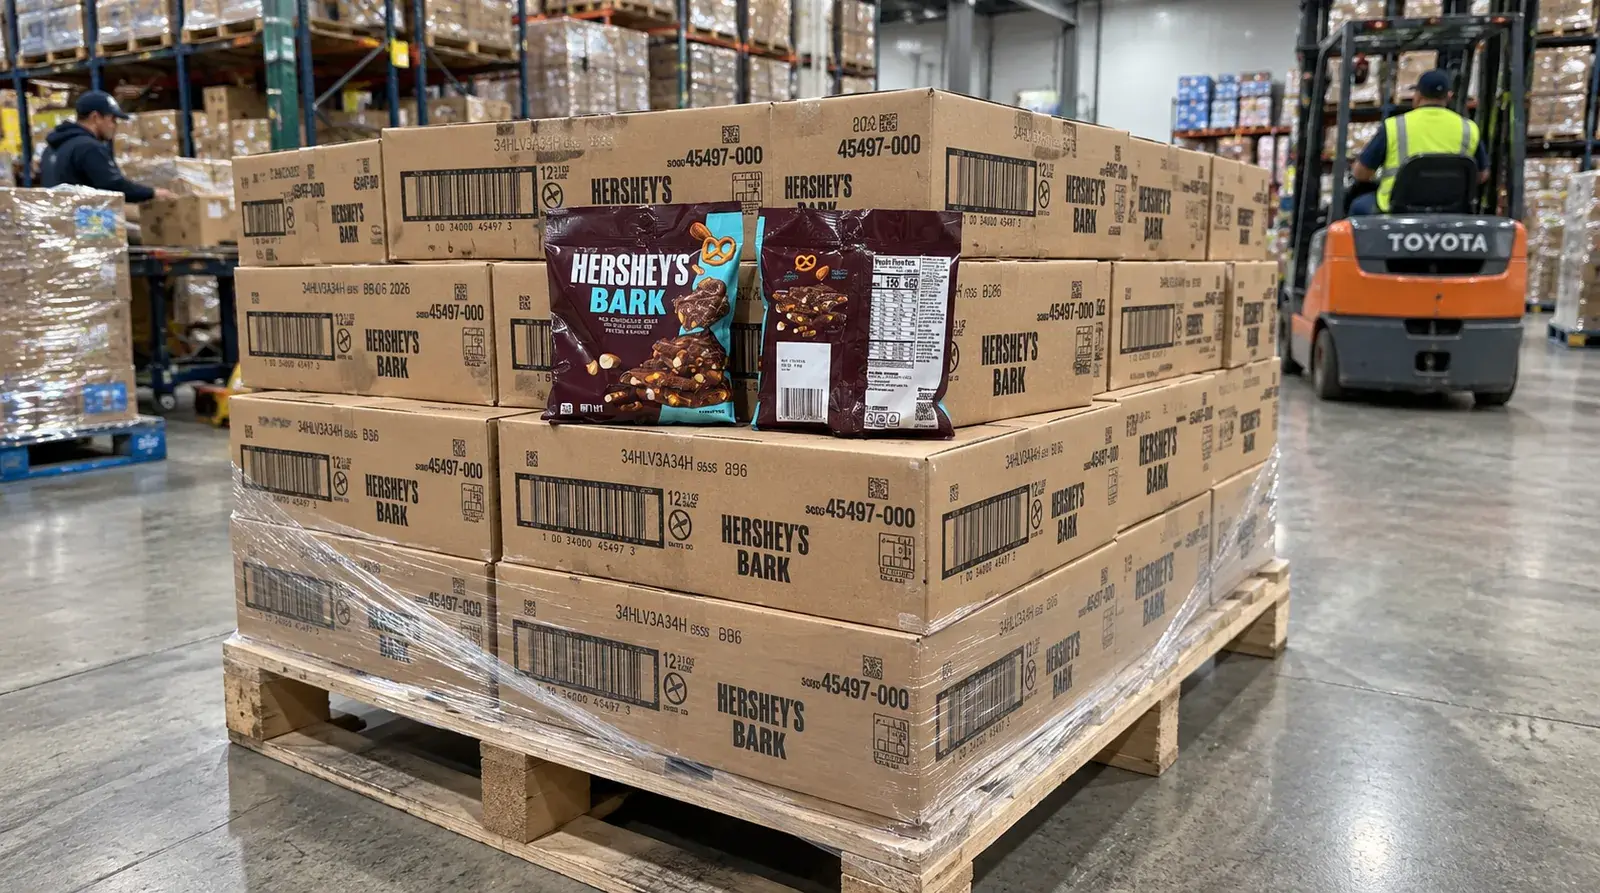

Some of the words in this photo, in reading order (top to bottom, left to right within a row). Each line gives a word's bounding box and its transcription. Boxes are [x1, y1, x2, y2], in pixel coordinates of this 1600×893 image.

[685, 145, 764, 168] 45497-000
[837, 134, 921, 159] 45497-000
[591, 175, 673, 205] HERSHEY'S
[784, 173, 852, 200] HERSHEY'S
[1065, 174, 1106, 206] HERSHEY'S
[1073, 207, 1097, 234] BARK
[1387, 232, 1488, 252] TOYOTA
[570, 253, 690, 287] HERSHEY'S
[390, 282, 411, 295] 2026
[589, 286, 667, 316] BARK
[429, 303, 484, 321] 45497-000
[1049, 301, 1094, 321] 45497-000
[365, 328, 420, 355] HERSHEY'S
[981, 331, 1038, 366] HERSHEY'S
[376, 355, 409, 379] BARK
[993, 366, 1026, 397] BARK
[621, 448, 694, 472] 34HLV3A34H
[1139, 426, 1178, 467] HERSHEY'S
[428, 457, 483, 479] 45497-000
[1146, 462, 1169, 496] BARK
[365, 473, 419, 504] HERSHEY'S
[667, 490, 682, 507] 12
[376, 500, 409, 527] BARK
[825, 498, 915, 529] 45497-000
[721, 513, 810, 556] HERSHEY'S
[1057, 512, 1078, 545] BARK
[542, 532, 547, 541] 1
[551, 533, 562, 544] 00
[566, 535, 592, 549] 34000
[598, 540, 624, 554] 45497
[630, 546, 635, 556] 3
[737, 549, 791, 584] BARK
[615, 603, 687, 634] 34HLV3A34H
[663, 652, 677, 670] 12
[821, 672, 909, 711] 45497-000
[626, 705, 631, 716] 3
[717, 682, 805, 733] HERSHEY'S
[733, 718, 787, 760] BARK
